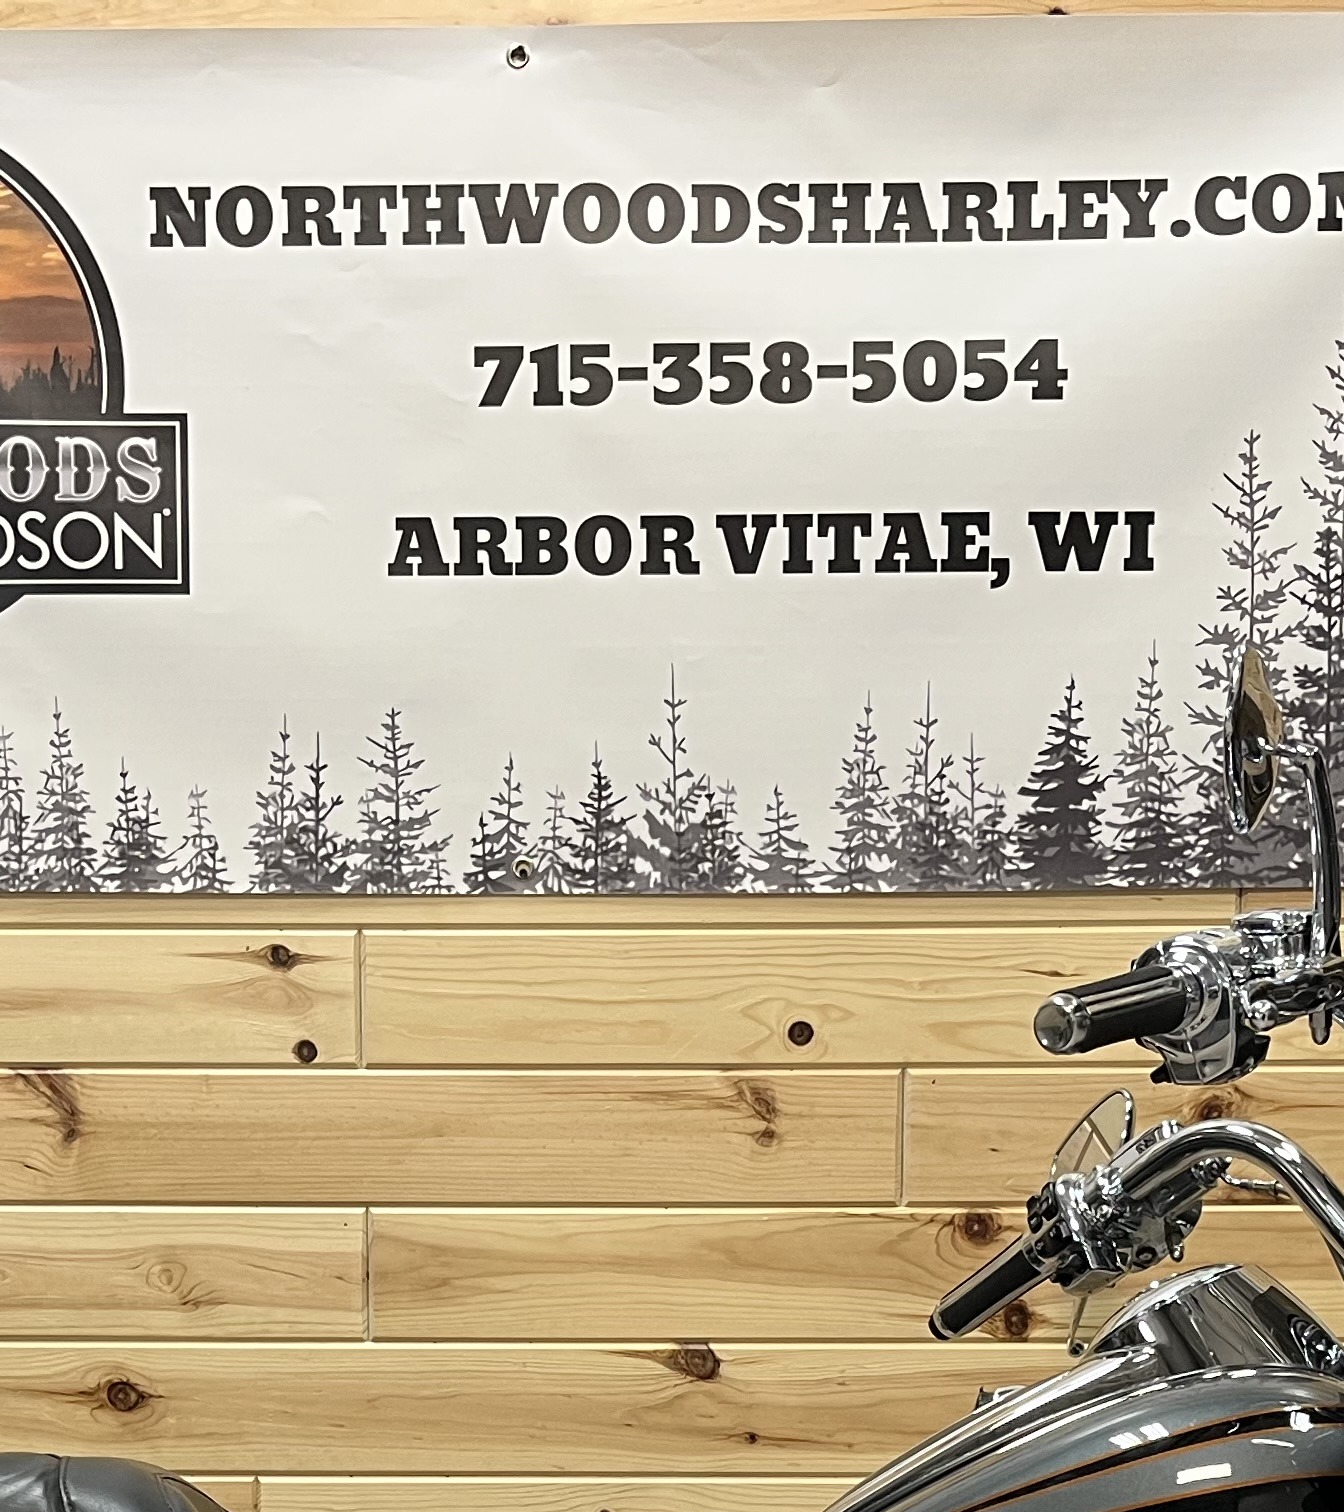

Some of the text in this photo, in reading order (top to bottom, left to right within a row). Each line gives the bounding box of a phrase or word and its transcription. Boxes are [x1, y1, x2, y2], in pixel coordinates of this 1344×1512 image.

[473, 339, 1068, 408] 715-358-5054
[387, 509, 1156, 590] ARBOR VITAE, WI
